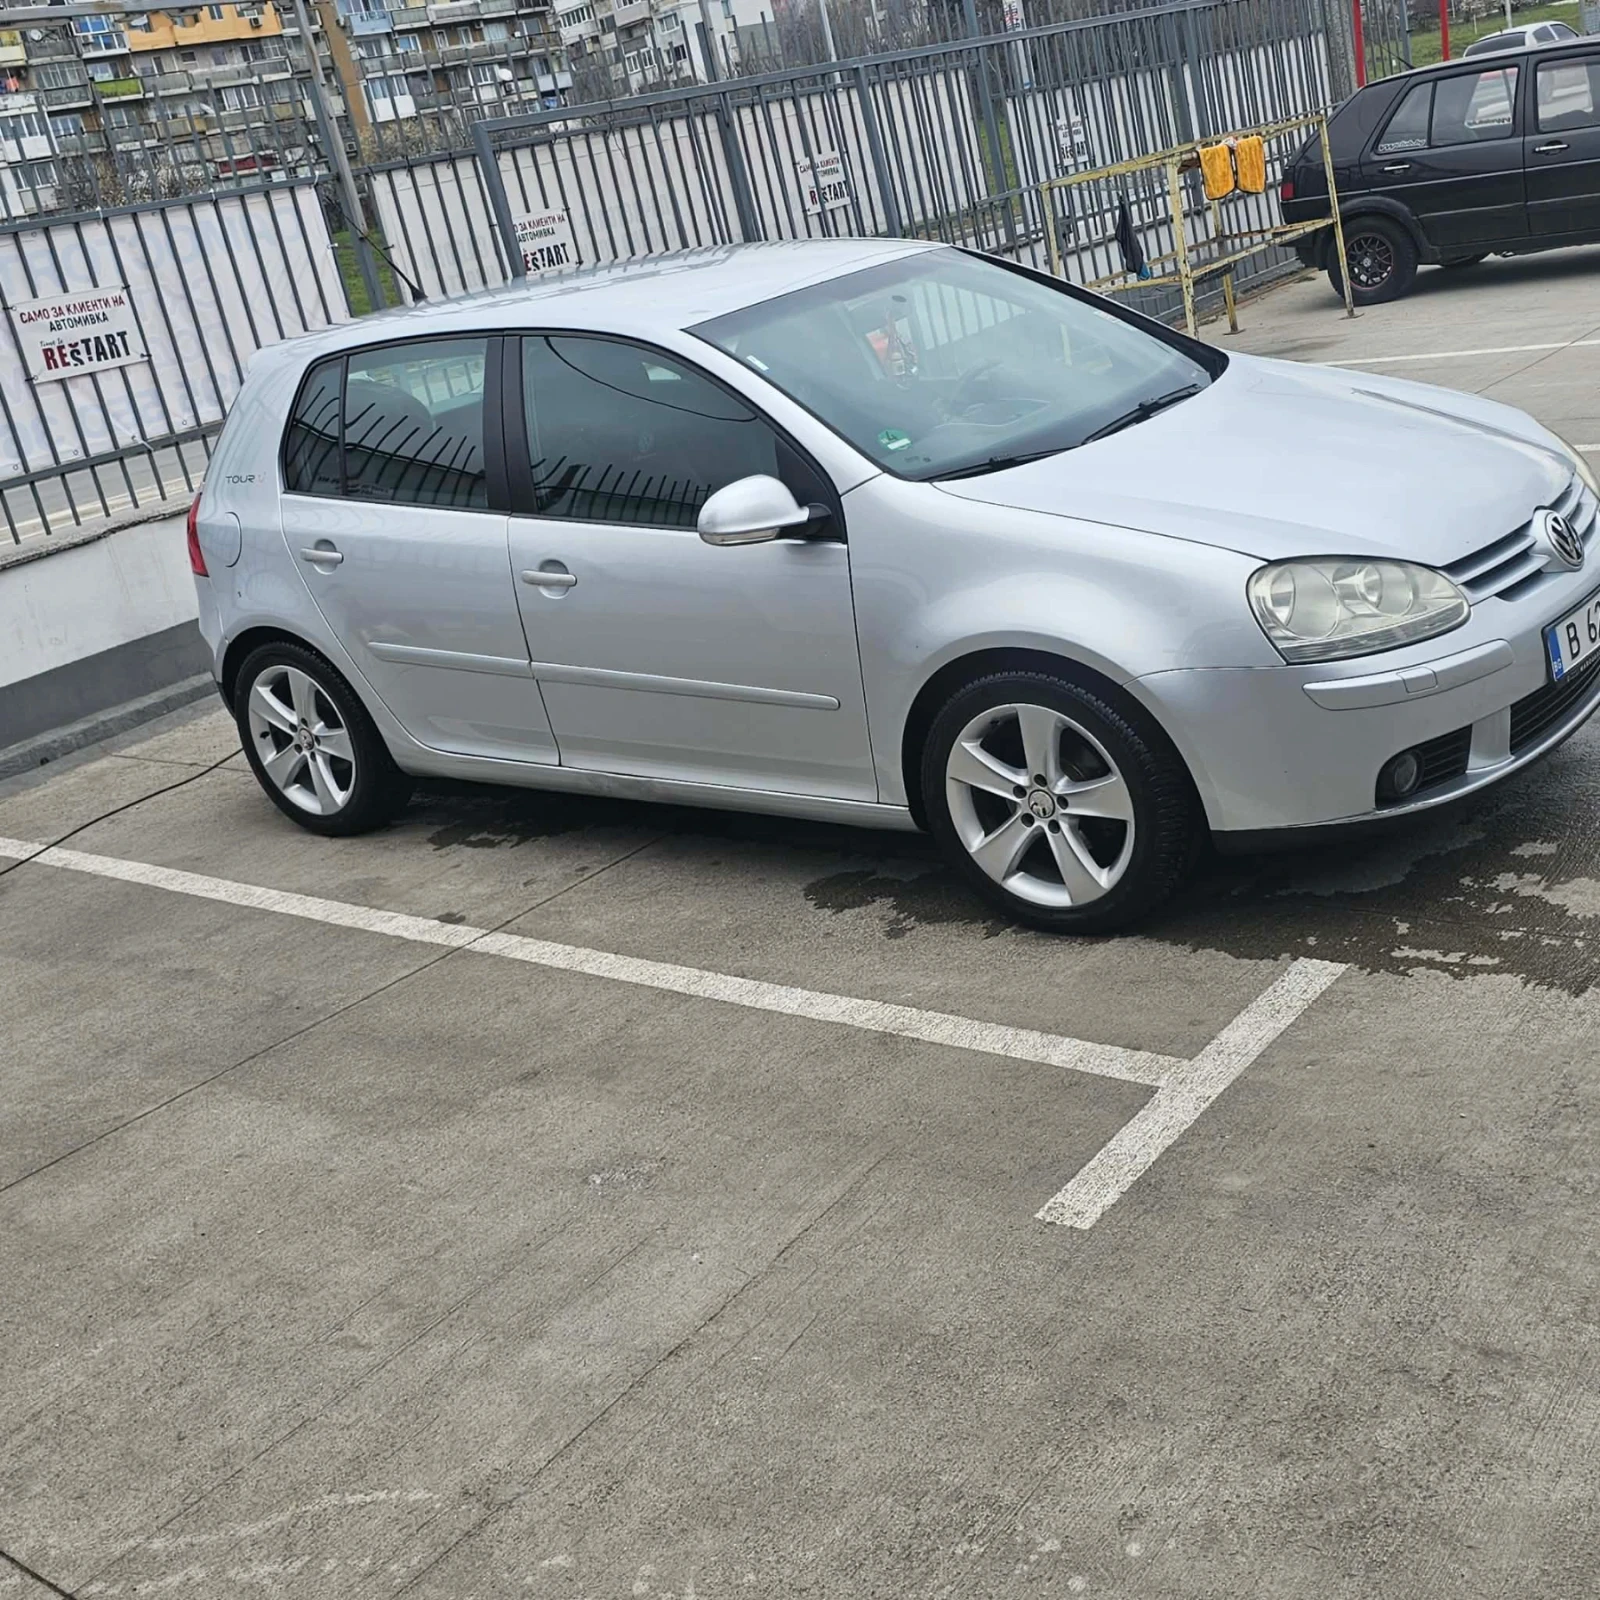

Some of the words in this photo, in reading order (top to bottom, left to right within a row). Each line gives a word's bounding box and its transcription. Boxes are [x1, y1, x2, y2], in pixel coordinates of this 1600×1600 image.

[20, 308, 51, 324] САМО
[51, 306, 65, 319] ЗА
[65, 298, 112, 316] КЛИЕНТИ
[111, 295, 125, 307] НА
[49, 311, 109, 332] АВТОМИВКА
[225, 474, 256, 484] TOUR
